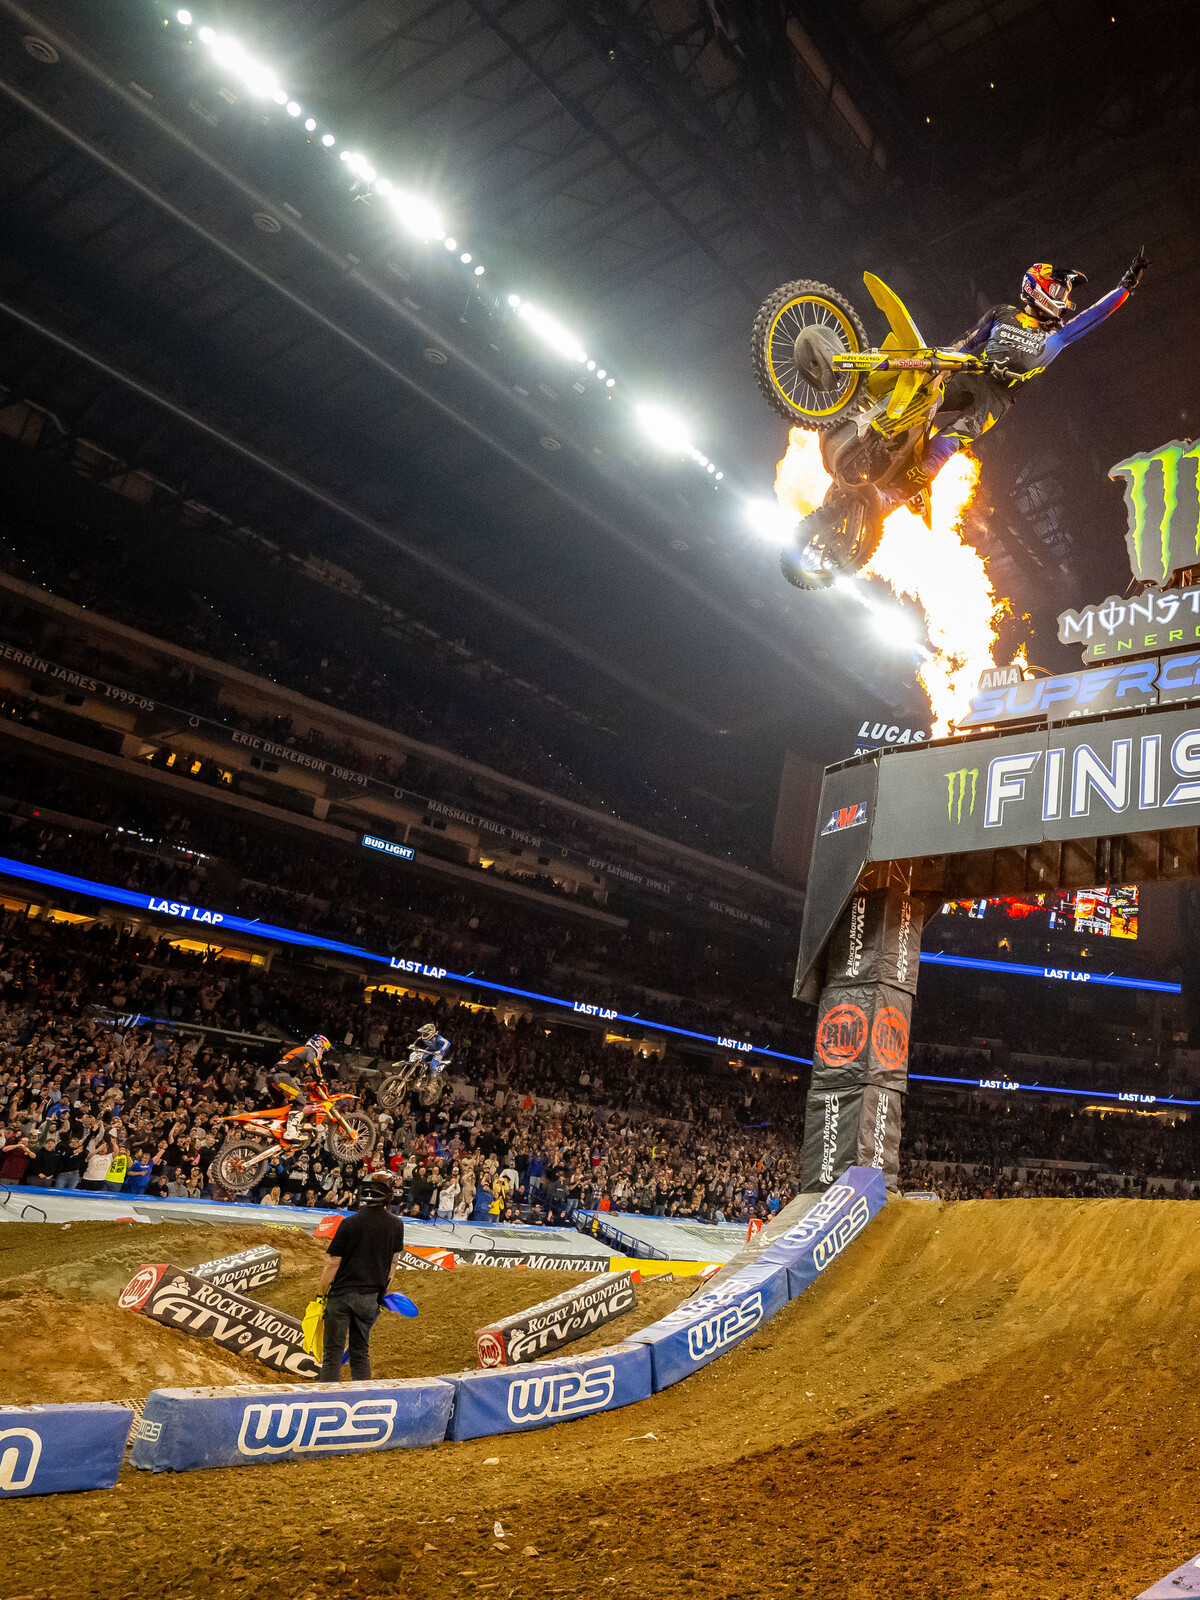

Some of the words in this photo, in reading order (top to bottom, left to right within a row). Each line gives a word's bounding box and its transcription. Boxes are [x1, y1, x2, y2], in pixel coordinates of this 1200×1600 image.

[1000, 331, 1040, 349] SUZUKI
[50, 667, 98, 692] JAMES
[103, 686, 155, 712] 1999-05
[981, 669, 1018, 688] AMA
[858, 721, 926, 743] LUCAS
[231, 732, 262, 749] ERIC
[262, 742, 327, 773] DICKERSON
[330, 766, 368, 788] 1987-91
[427, 801, 476, 826] MARSHALL
[478, 818, 506, 836] FAULK
[821, 802, 867, 833] AMA
[364, 837, 386, 850] BUD
[384, 842, 413, 859] LIGHT
[586, 857, 606, 871] JEFF
[606, 862, 644, 884] SATURDAY
[147, 897, 191, 918] LAST
[192, 908, 224, 925] LAP
[390, 957, 423, 973] LAST
[422, 964, 447, 979] LAP
[1044, 968, 1070, 980] LAST
[1071, 971, 1091, 982] LAP
[573, 1002, 599, 1016] LAST
[599, 1007, 618, 1020] LAP
[717, 1037, 738, 1049] LAST
[737, 1041, 753, 1052] LAP
[979, 1080, 1001, 1089] LAST
[1002, 1082, 1020, 1090] LAP
[1118, 1092, 1139, 1102] LAST
[1139, 1094, 1156, 1103] LAP
[823, 1094, 831, 1140] MOUNTAIN
[874, 1092, 883, 1140] MOUNTAIN
[822, 1141, 830, 1170] ROCKY
[813, 1196, 869, 1271] WPS
[212, 1258, 279, 1286] MOUNTAIN
[472, 1253, 524, 1268] ROCKY
[527, 1255, 608, 1272] MOUNTAIN
[191, 1284, 251, 1320] ROCKY
[248, 1308, 306, 1348] MOUNT
[527, 1306, 569, 1334] ROCKY
[571, 1275, 631, 1314] MOUNTAIN
[688, 1291, 764, 1361] WPS
[507, 1365, 614, 1423] WPS
[238, 1399, 397, 1455] WPS
